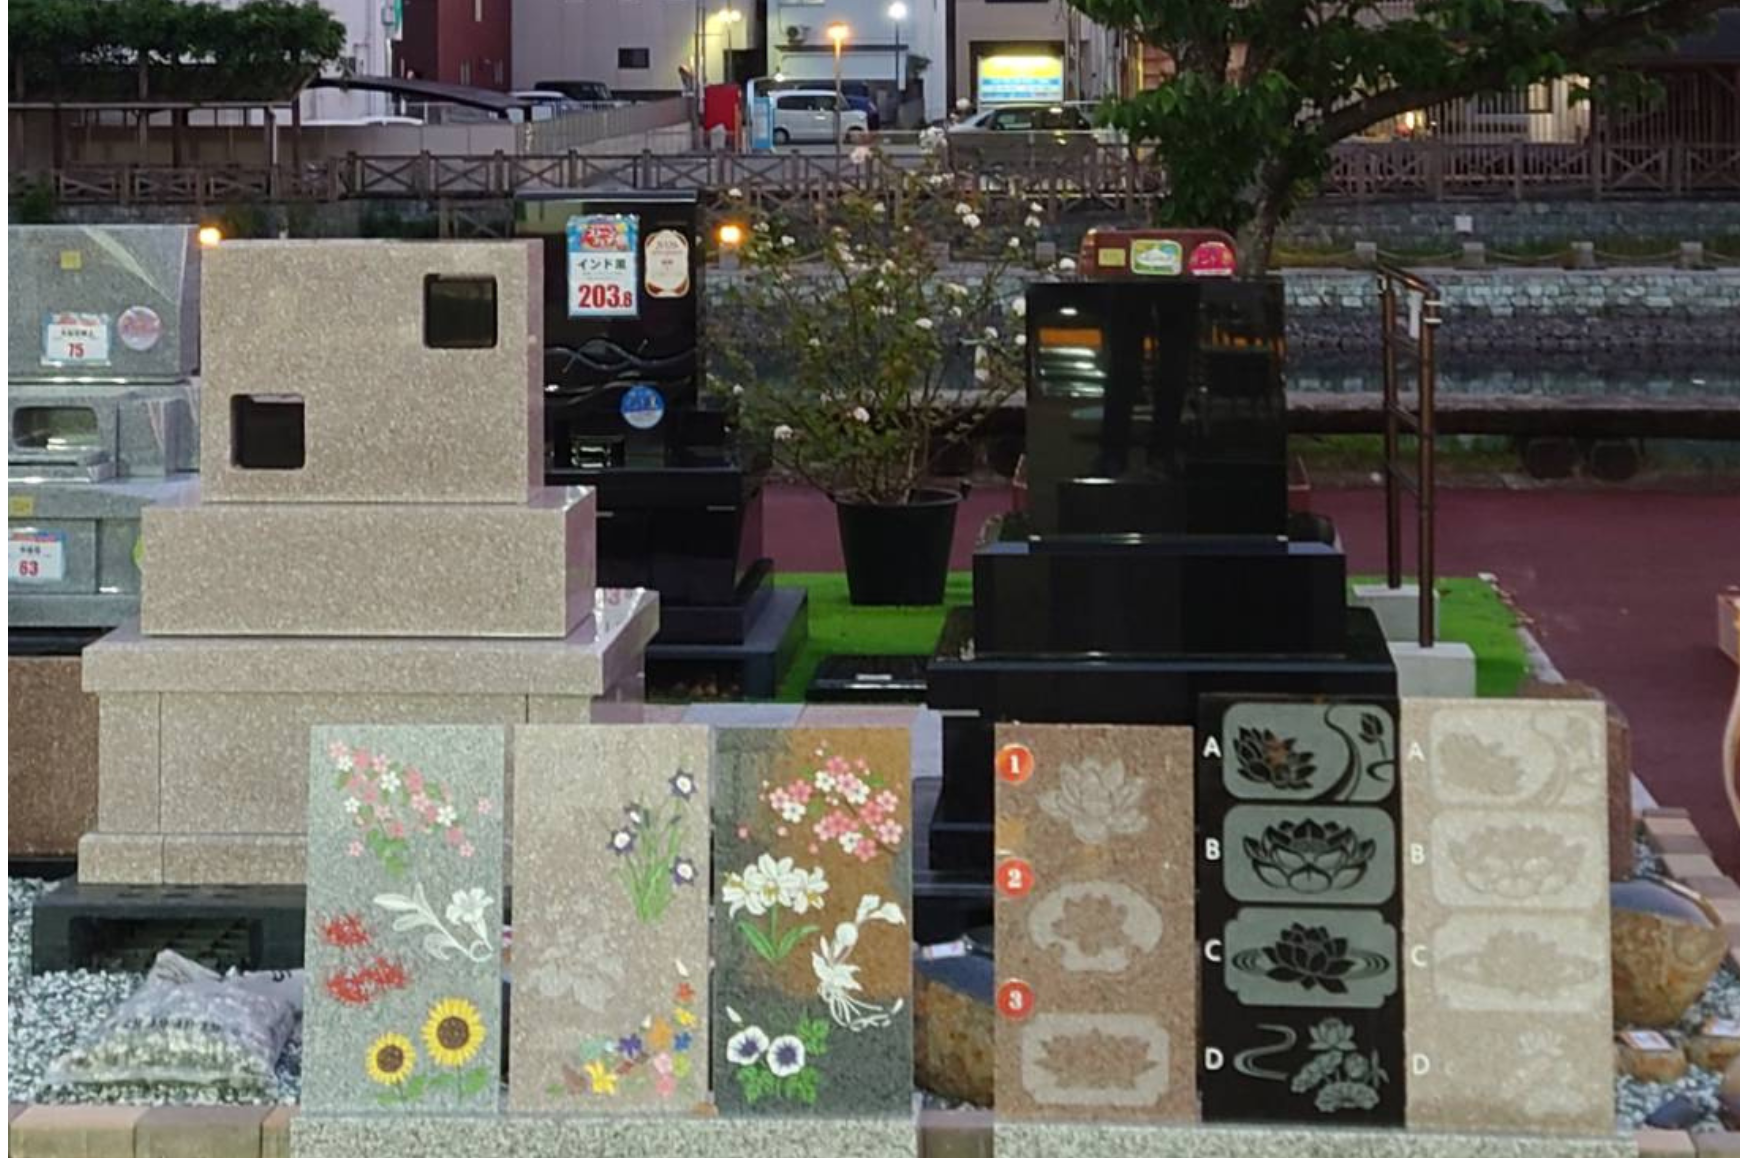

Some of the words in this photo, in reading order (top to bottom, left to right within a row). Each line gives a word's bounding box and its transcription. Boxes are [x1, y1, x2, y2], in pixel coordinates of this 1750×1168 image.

[1203, 735, 1222, 758] A
[1408, 741, 1425, 761] A
[1009, 754, 1020, 774] 1
[1205, 837, 1221, 860] B
[1410, 843, 1425, 864] B
[1007, 868, 1023, 888] 2
[1204, 938, 1222, 961] C
[1411, 944, 1428, 966] C
[1008, 990, 1023, 1011] 3
[1205, 1046, 1224, 1070] D
[1413, 1053, 1430, 1075] D
